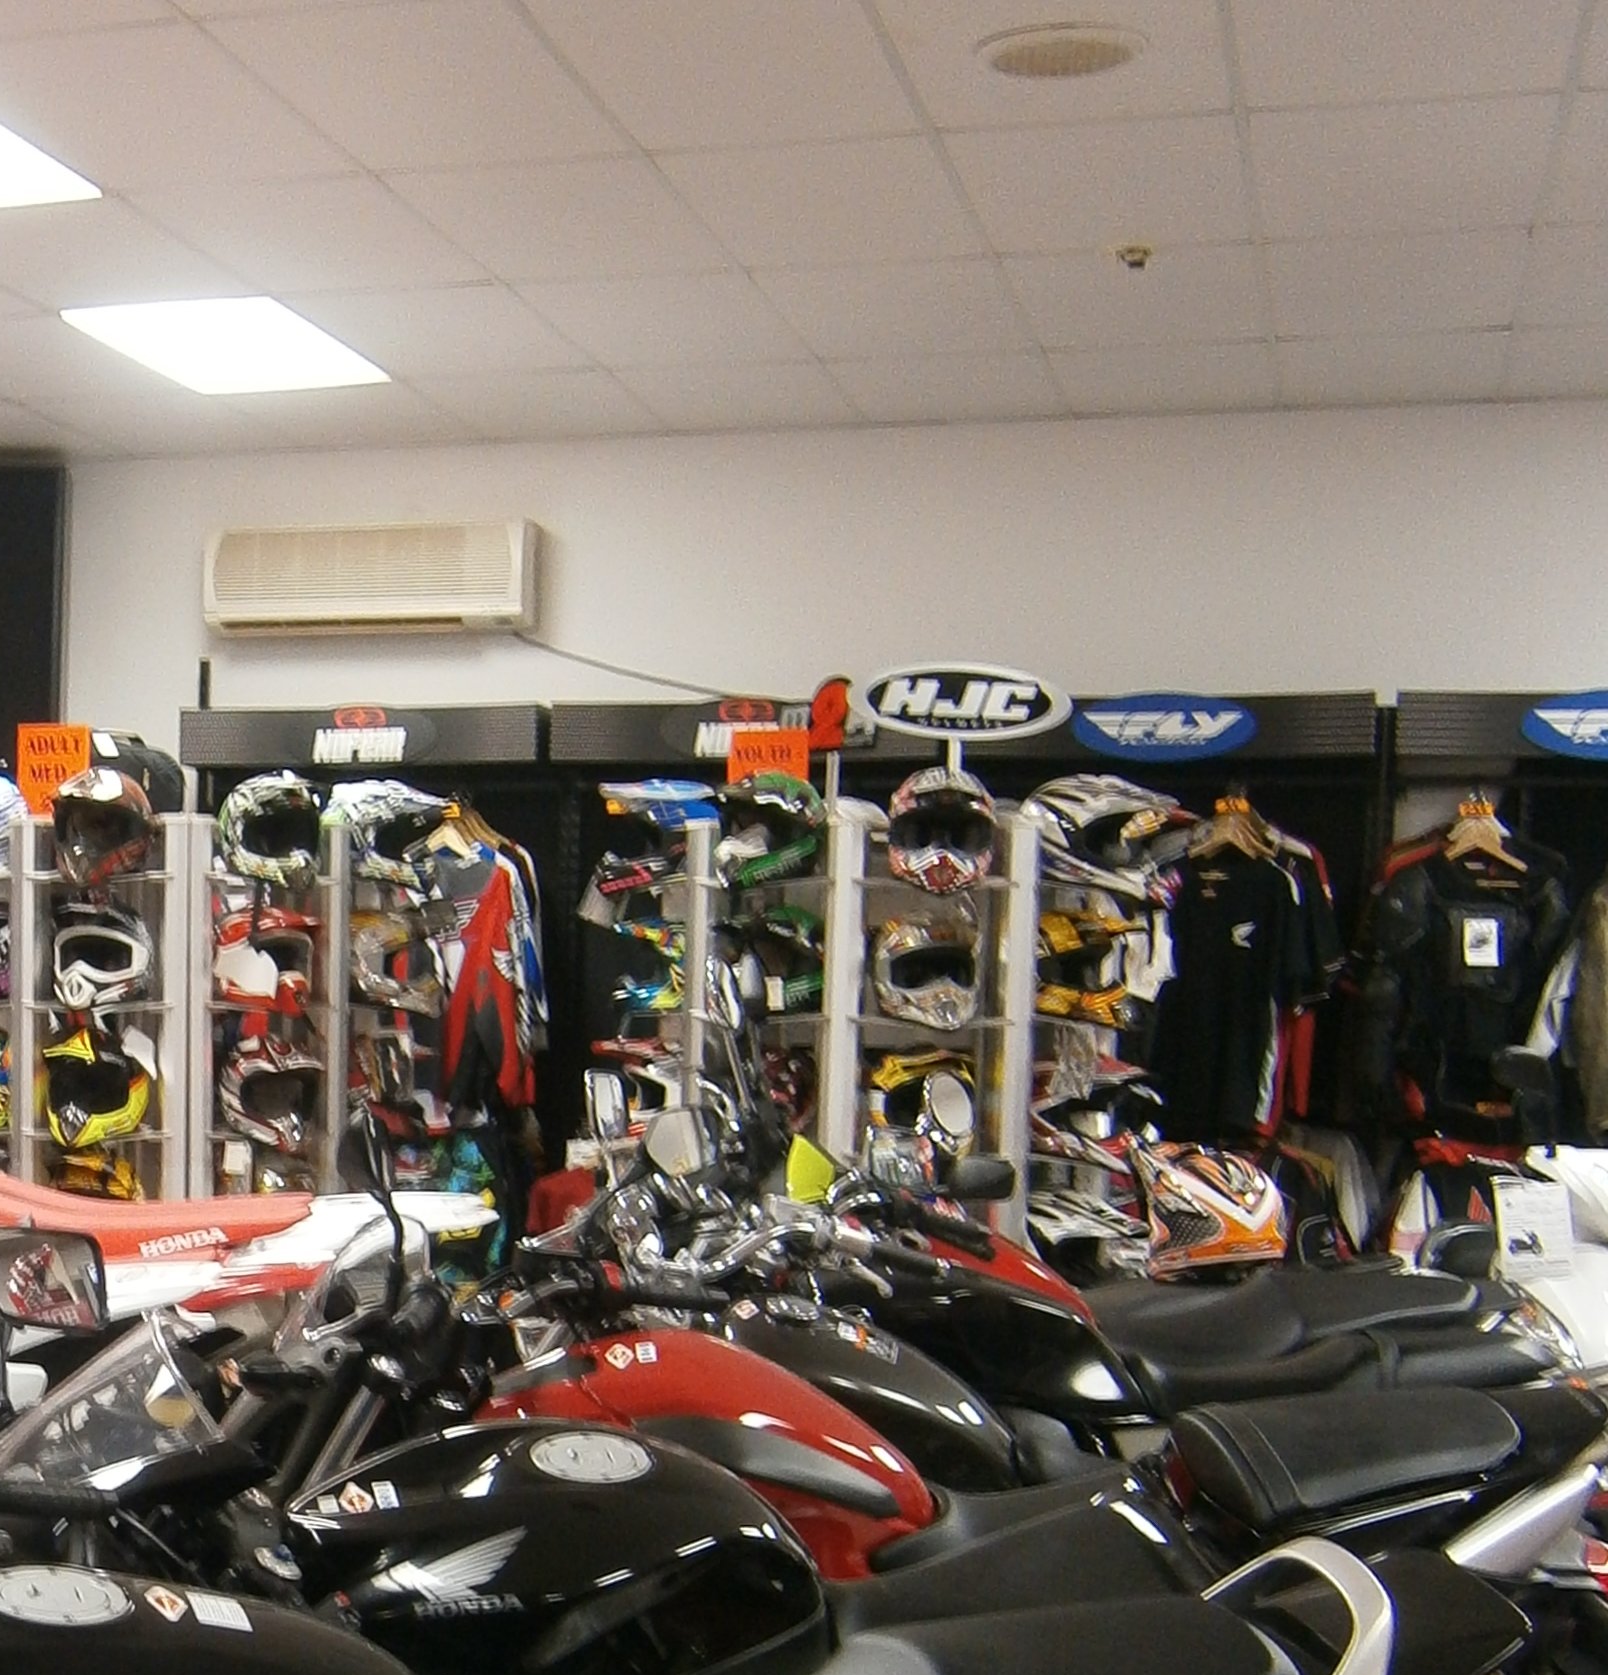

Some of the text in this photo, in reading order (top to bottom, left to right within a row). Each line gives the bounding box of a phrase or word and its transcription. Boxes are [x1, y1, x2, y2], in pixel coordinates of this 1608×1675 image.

[879, 677, 1039, 721] HJC
[1083, 710, 1243, 739] FLY
[26, 735, 83, 755] ADULT
[138, 1226, 230, 1258] HONDA
[412, 1593, 524, 1618] HONDA
